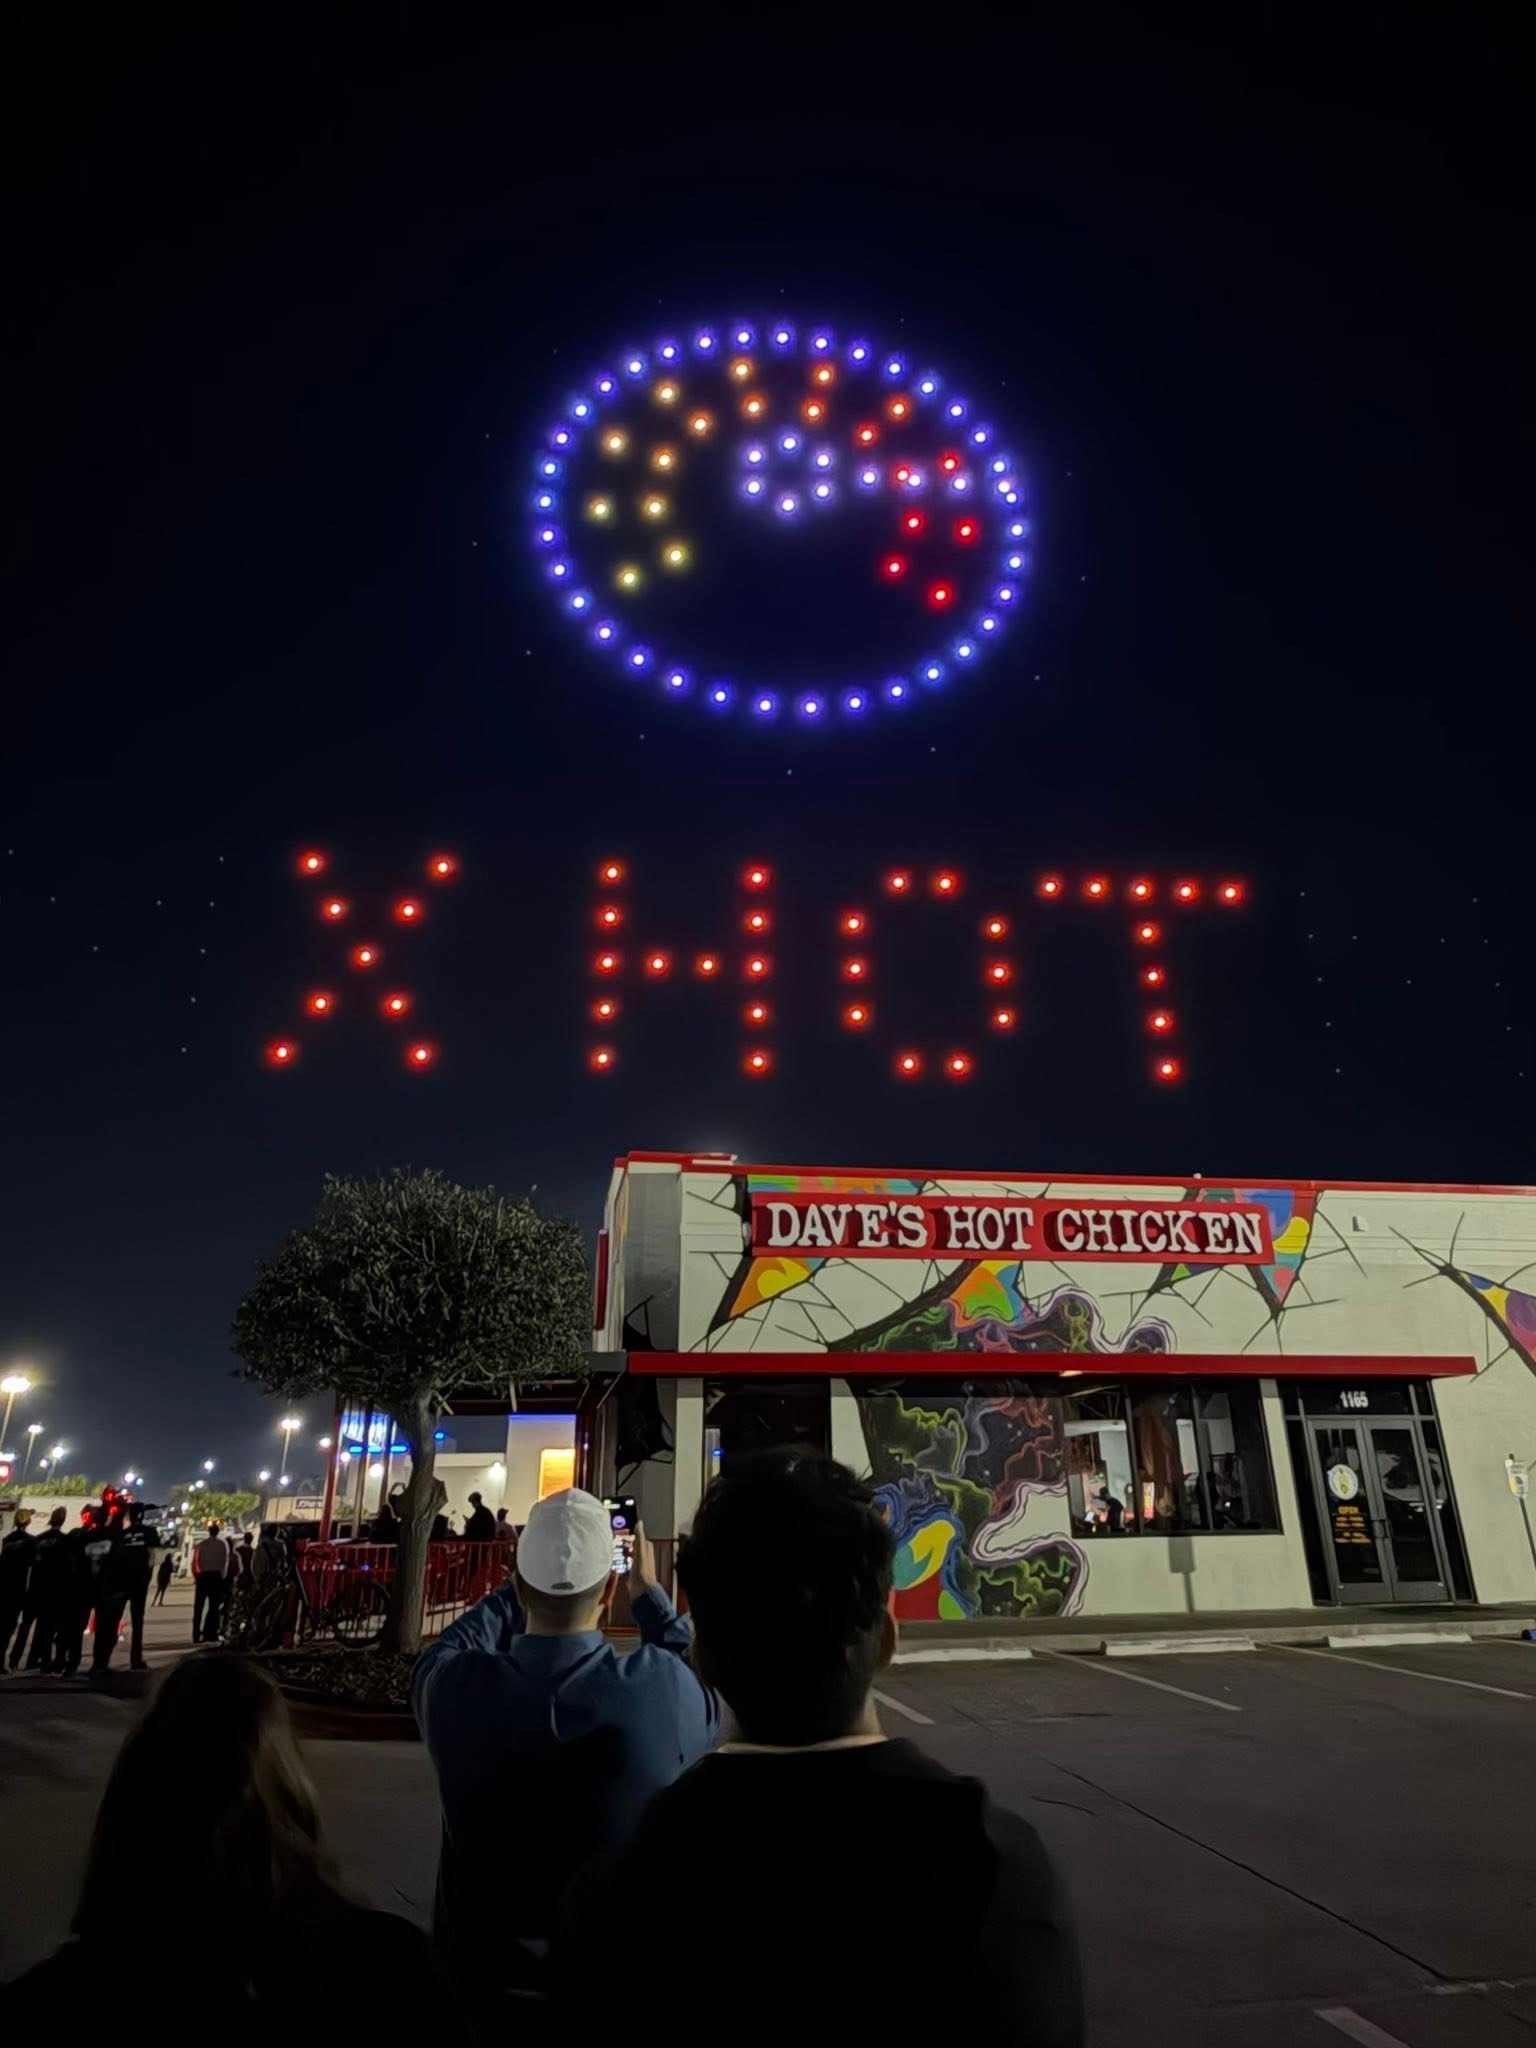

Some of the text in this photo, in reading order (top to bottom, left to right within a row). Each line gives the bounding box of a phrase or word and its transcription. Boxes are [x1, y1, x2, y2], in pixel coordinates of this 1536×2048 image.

[268, 852, 1245, 1081] X HOT
[766, 1201, 1264, 1254] DAVE'S HOT CHICKEN
